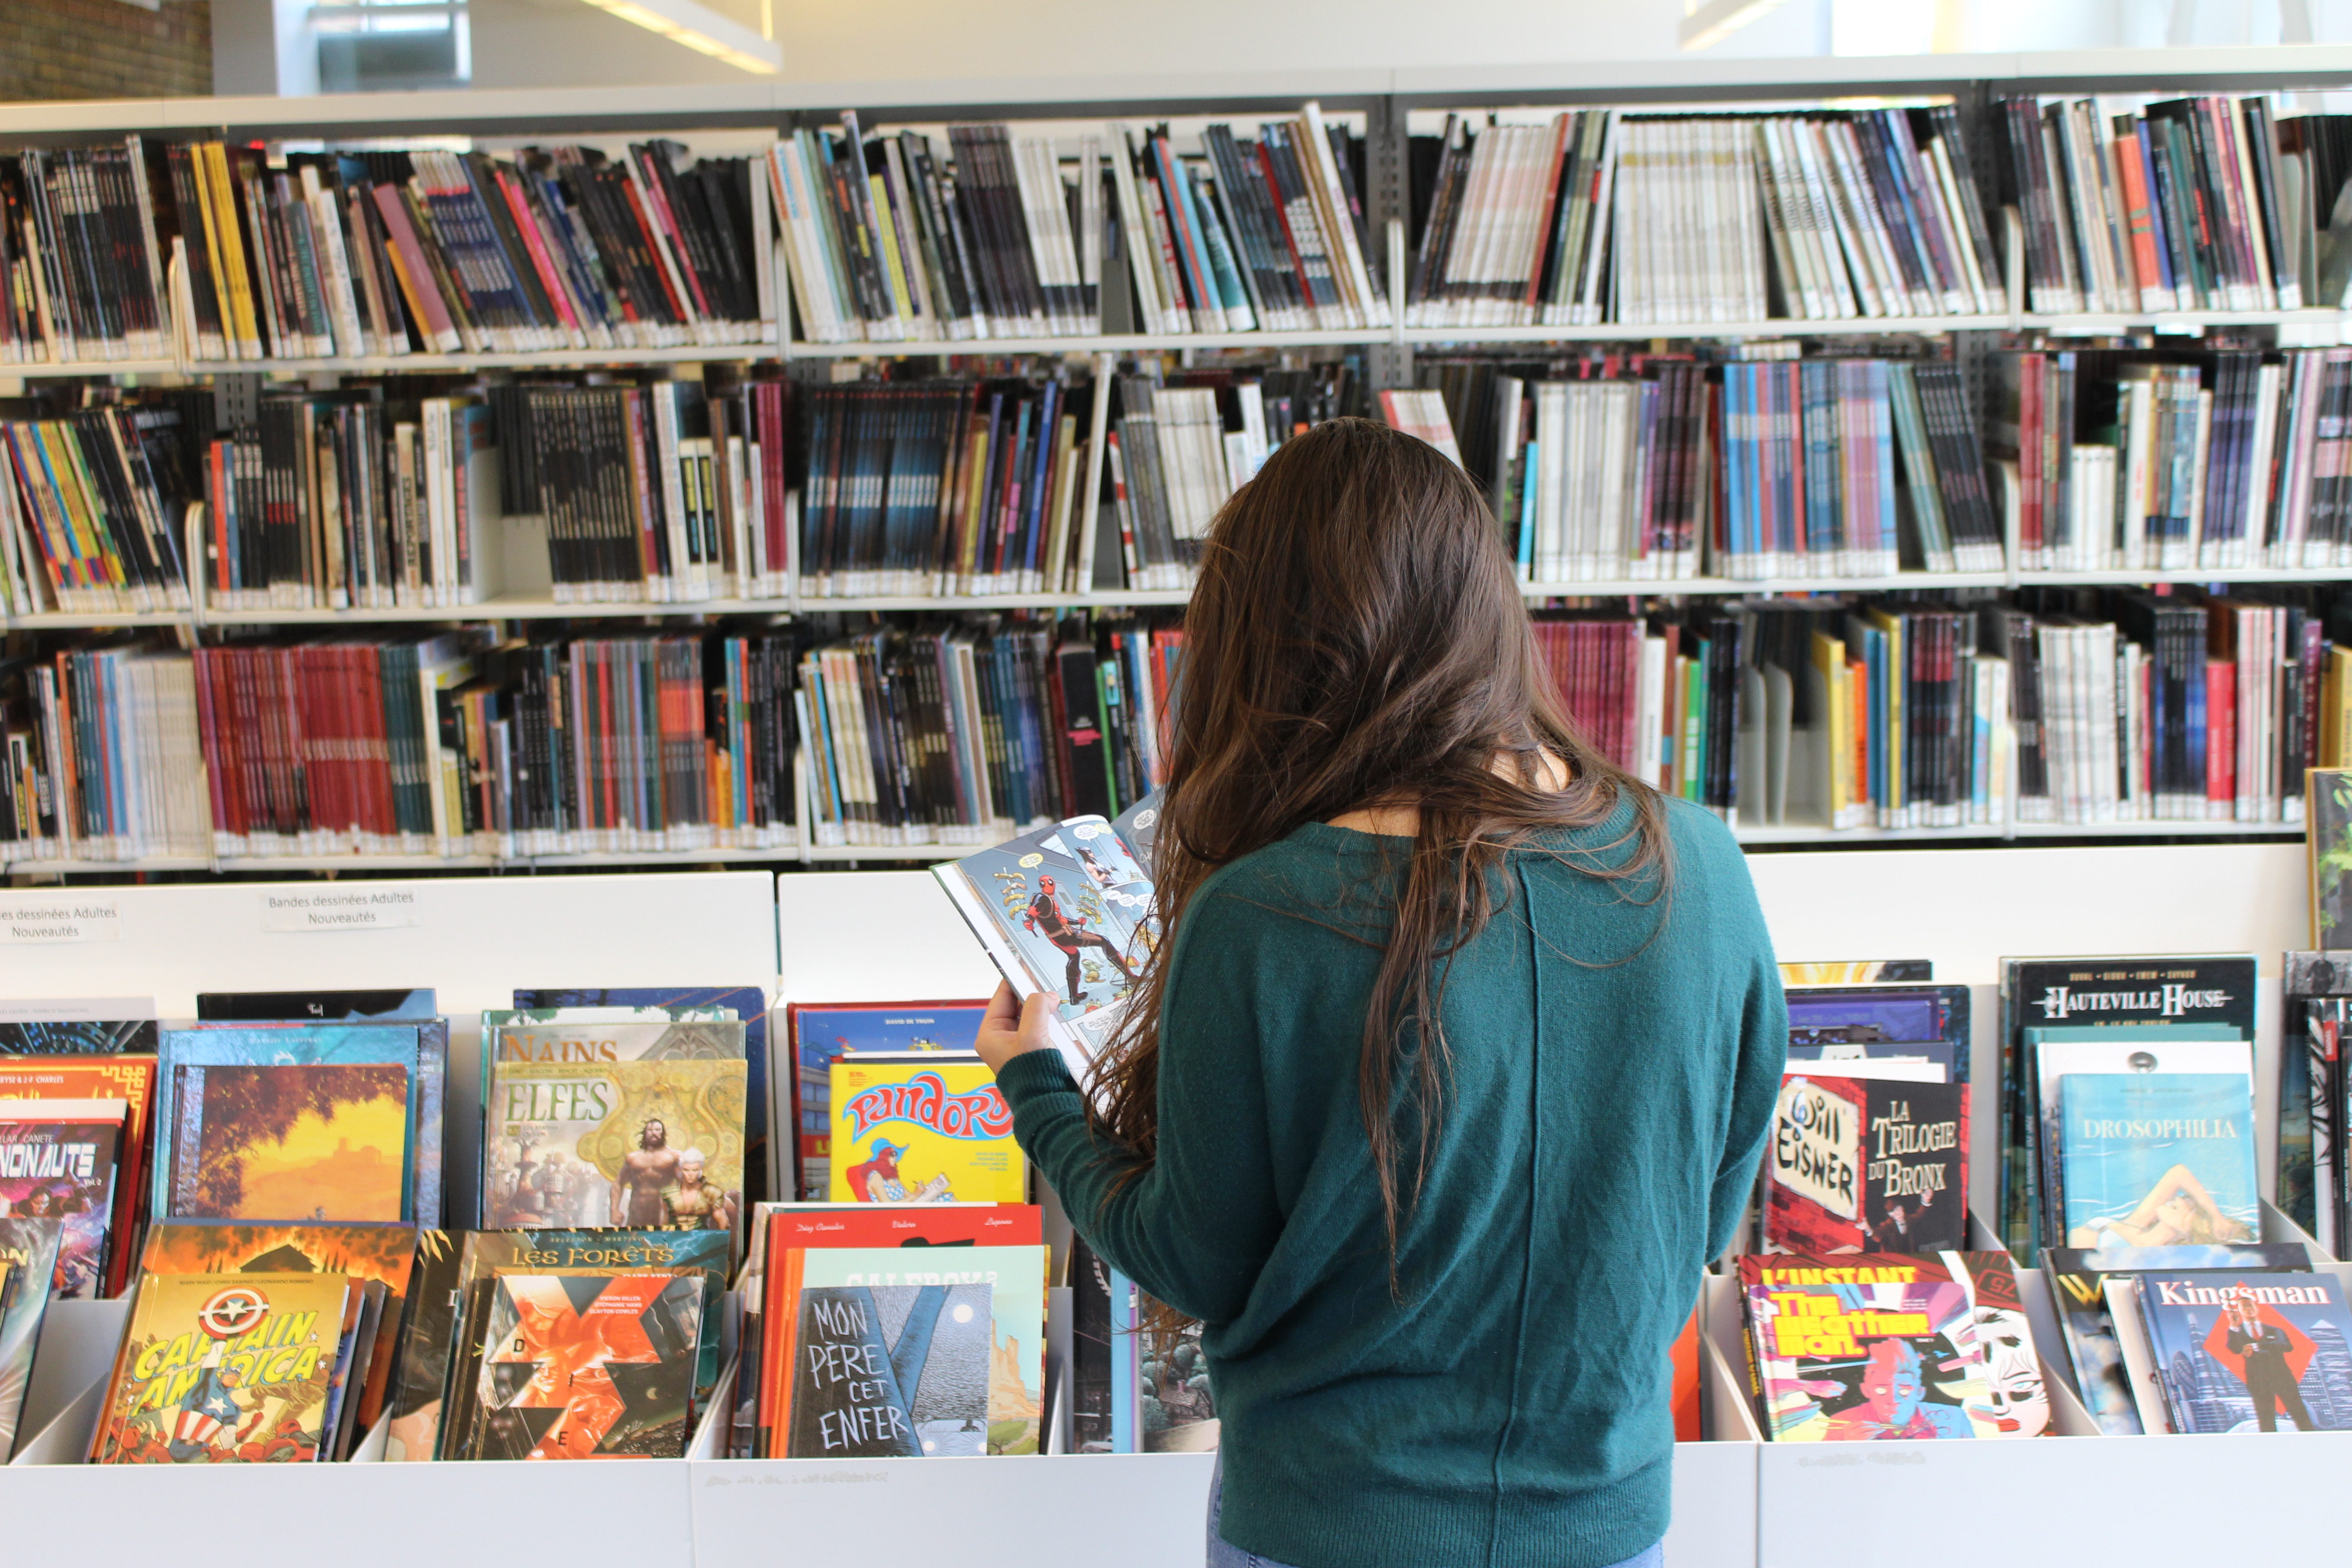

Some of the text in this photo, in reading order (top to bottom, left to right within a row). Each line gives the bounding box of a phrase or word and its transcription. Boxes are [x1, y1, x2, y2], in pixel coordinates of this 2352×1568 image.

[0, 907, 117, 920] es dessinées Adultes
[270, 893, 414, 908] Bandes dessinées Adultes
[309, 912, 377, 924] Nouveautés
[12, 926, 79, 938] Nouveautés
[2044, 984, 2225, 1019] HAUTEVILLE HOUSE
[503, 1035, 617, 1062] NAINS
[36, 1075, 64, 1083] CHARLES
[505, 1082, 608, 1121] ELFES
[1891, 1101, 1910, 1122] LA
[1792, 1091, 1840, 1145] Will
[2083, 1119, 2237, 1139] DROSOPHILIA
[1872, 1117, 1957, 1158] TRILOGIE
[1868, 1159, 1947, 1198] DU BRONX
[0, 1248, 29, 1267] N
[512, 1246, 674, 1268] LES FORÊTS
[2155, 1280, 2331, 1312] Kingsman
[813, 1298, 868, 1340] MON
[808, 1342, 885, 1390] PÈRE
[129, 1347, 320, 1417] AMRICA
[850, 1379, 888, 1403] CET
[819, 1406, 910, 1450] ENFER
